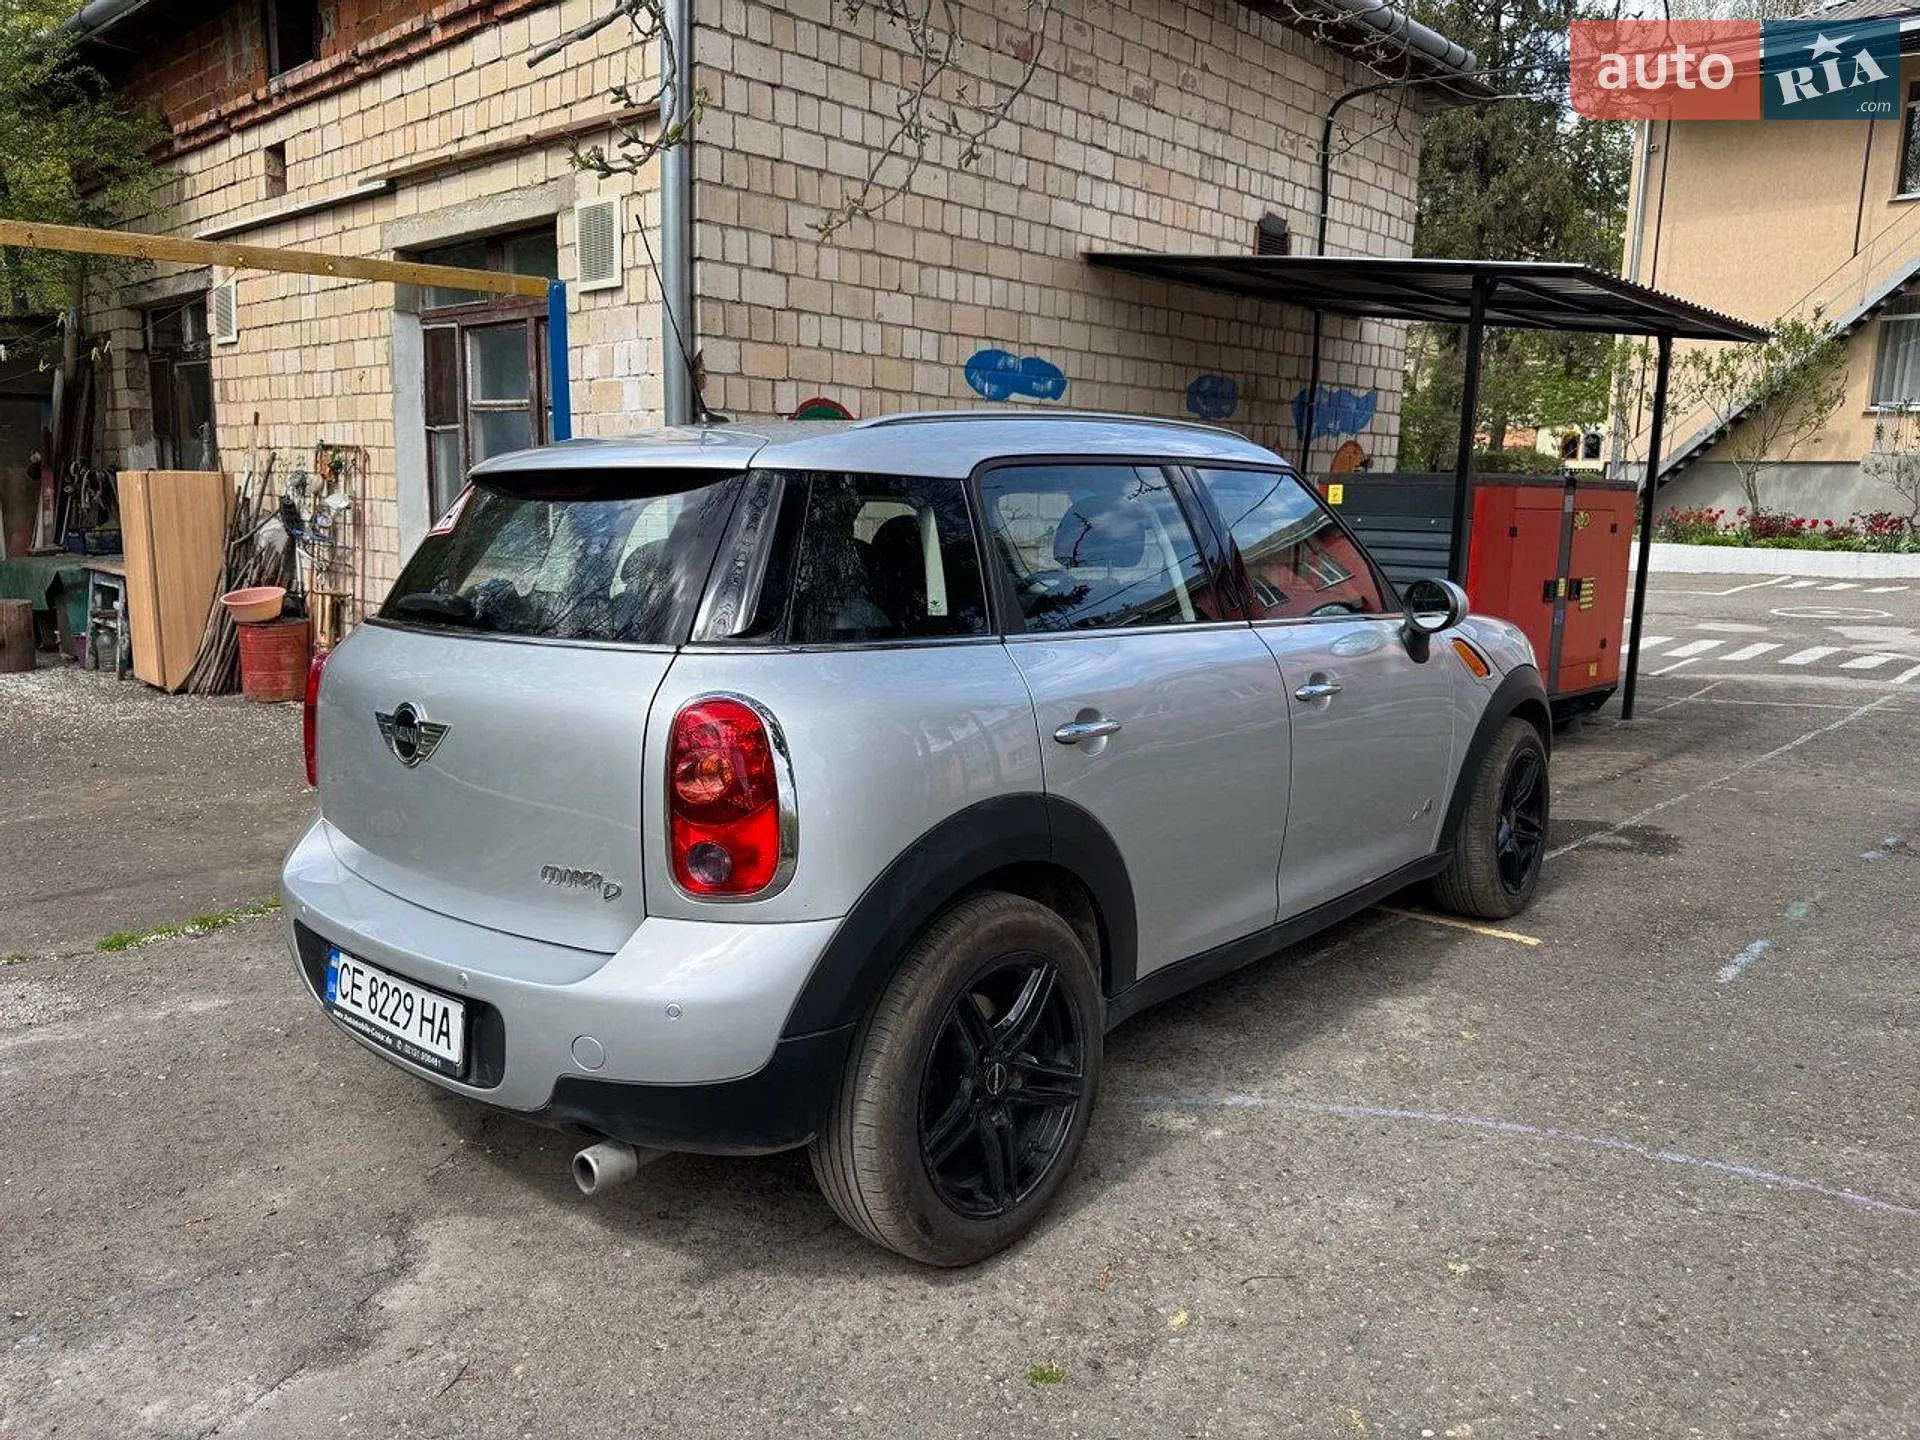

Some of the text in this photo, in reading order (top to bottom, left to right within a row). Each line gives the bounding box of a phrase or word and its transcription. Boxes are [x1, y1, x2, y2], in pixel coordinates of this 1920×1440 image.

[339, 962, 451, 1050] CE 8229 HA
